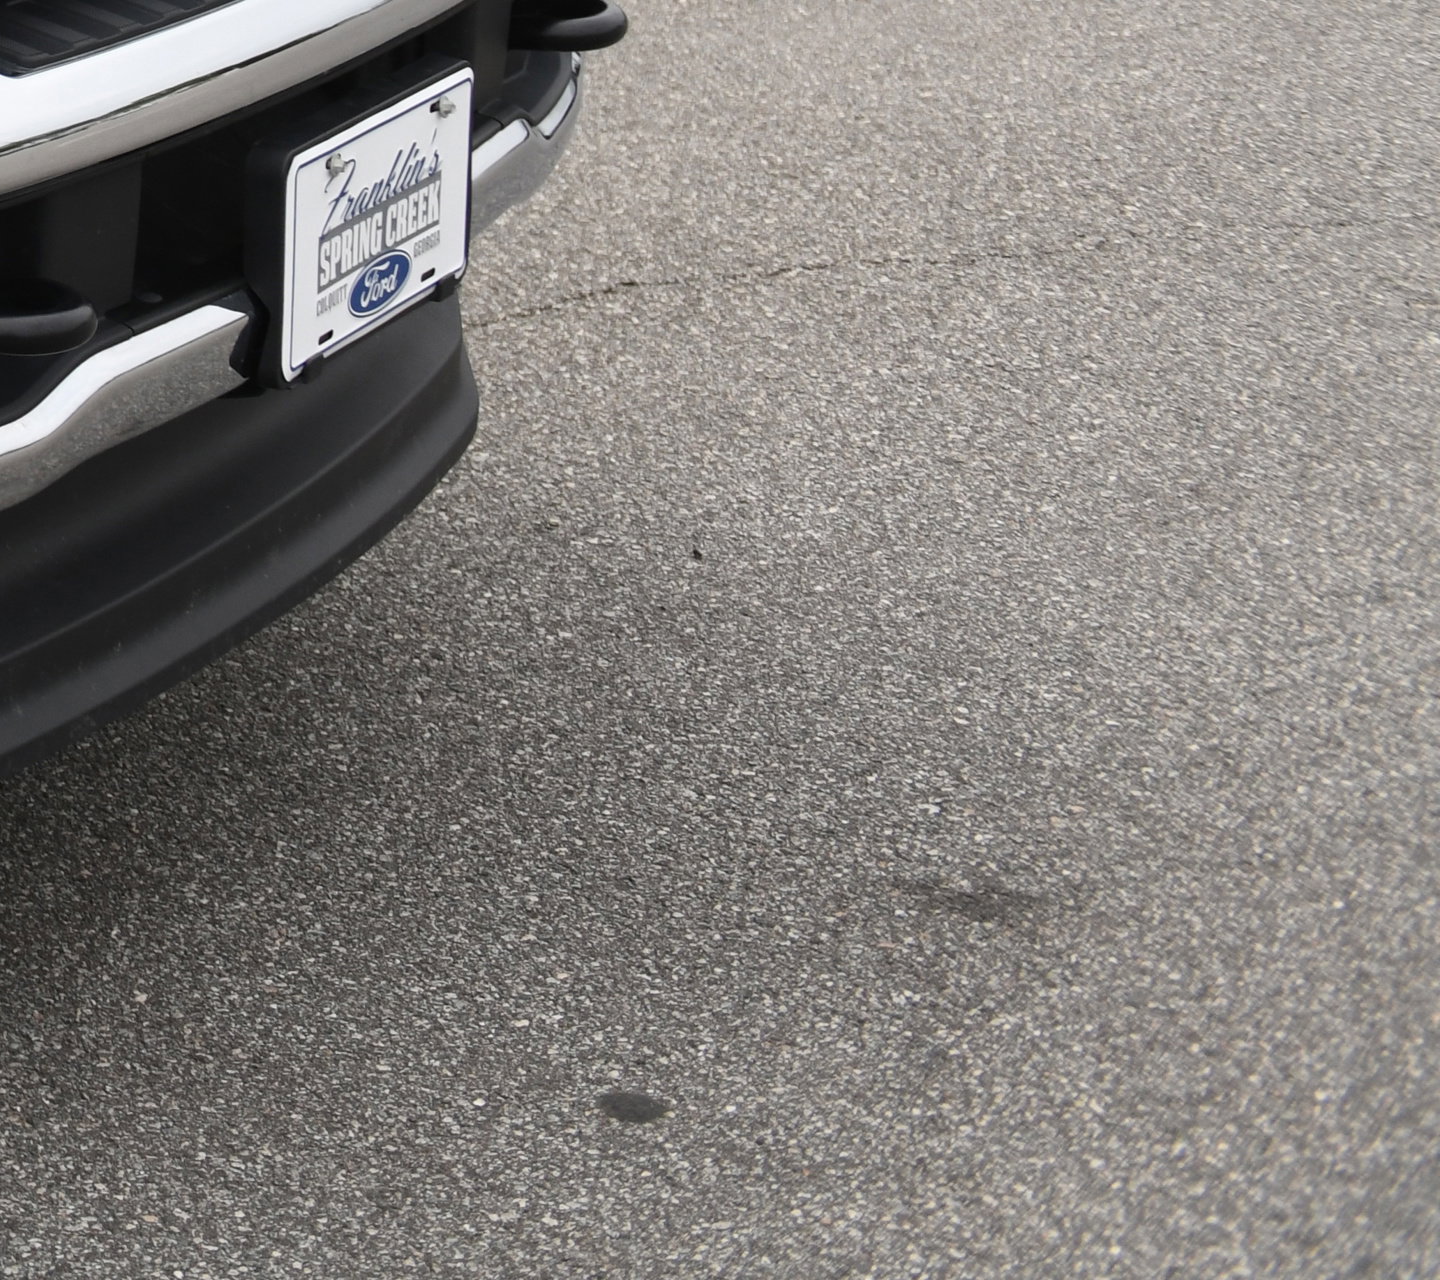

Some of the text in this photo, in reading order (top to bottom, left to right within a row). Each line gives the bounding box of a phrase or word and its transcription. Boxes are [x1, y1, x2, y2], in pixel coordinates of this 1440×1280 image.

[322, 128, 442, 238] Franklin's
[320, 180, 440, 286] SPRING CREEK
[413, 229, 441, 258] GEORGIA
[316, 283, 349, 316] COLQUITT
[360, 261, 399, 308] Ford
